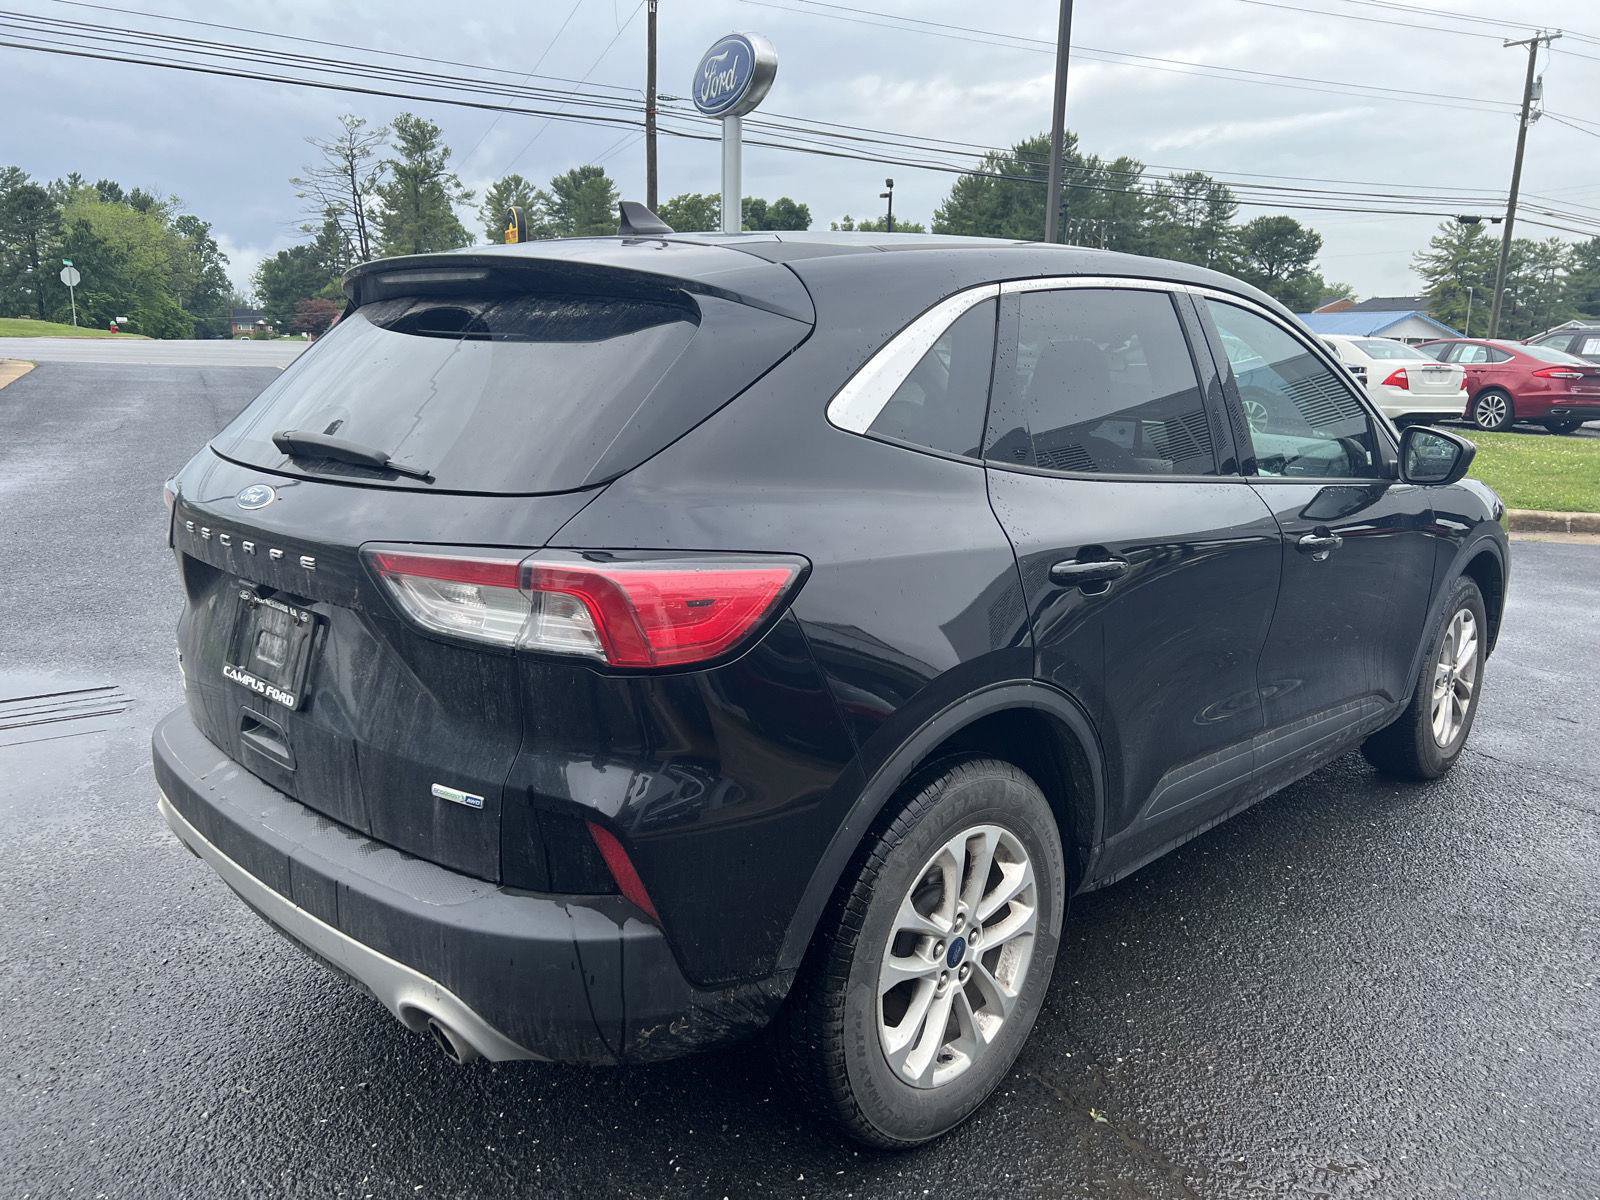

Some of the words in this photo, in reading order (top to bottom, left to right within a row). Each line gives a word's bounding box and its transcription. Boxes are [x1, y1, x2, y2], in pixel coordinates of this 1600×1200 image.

[701, 49, 739, 103] Ford
[186, 520, 316, 570] ESCAPE
[223, 665, 265, 693] CAMPUS
[265, 685, 295, 707] FORD
